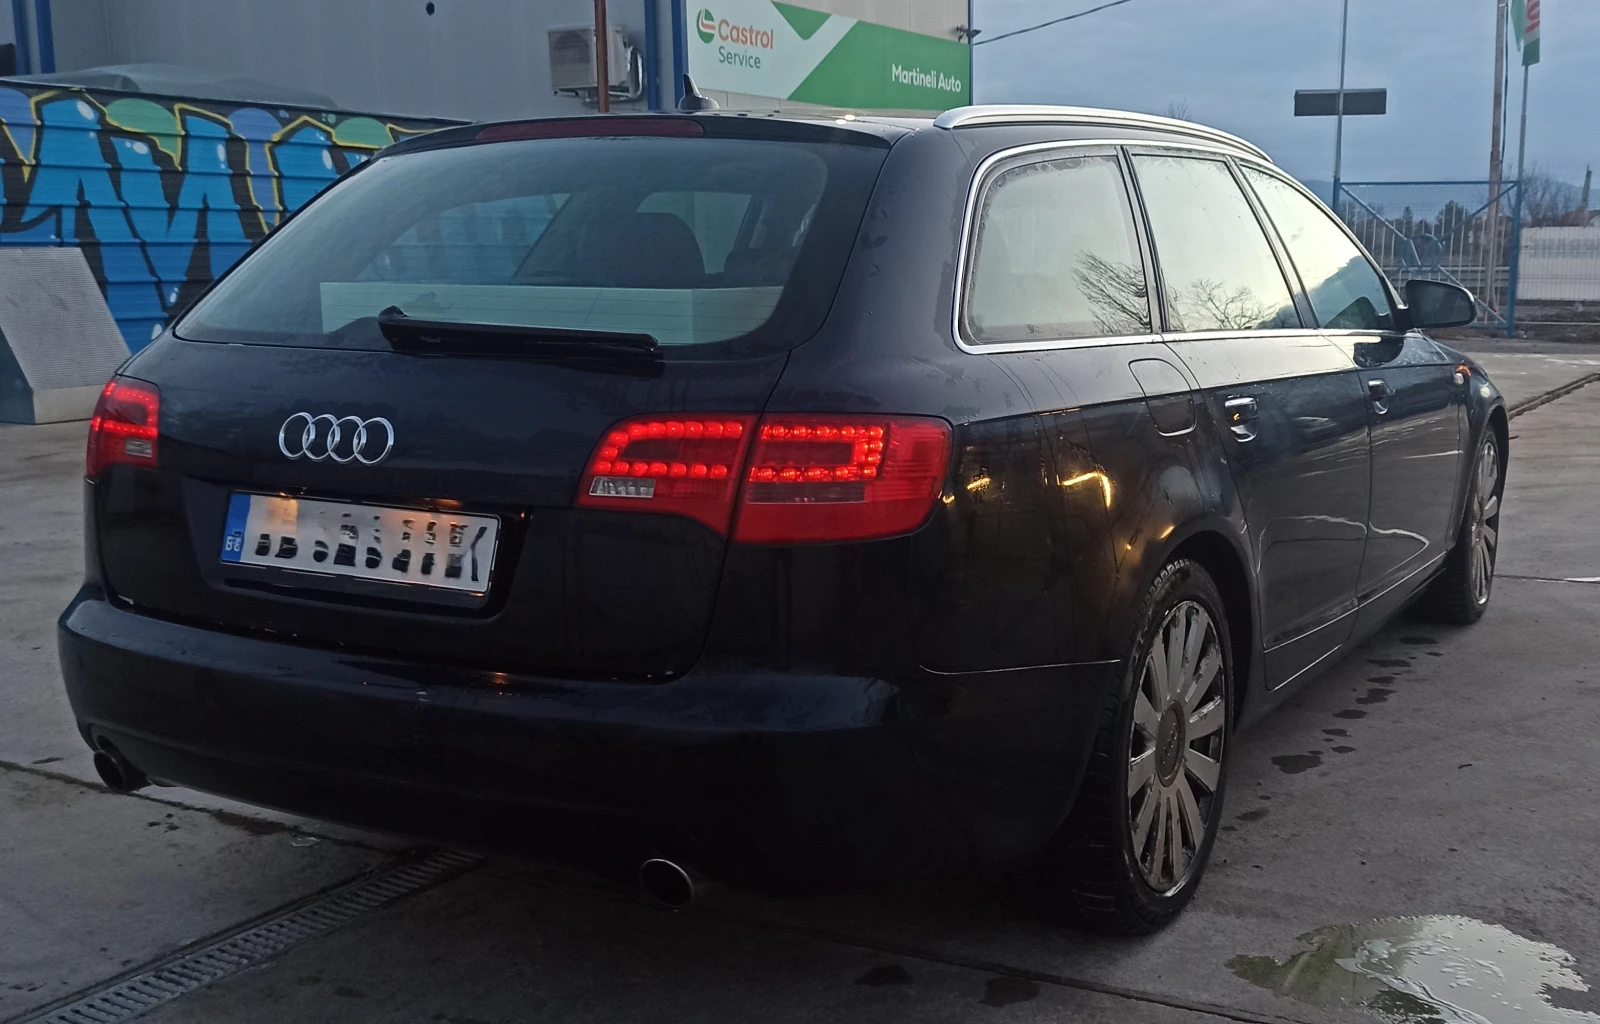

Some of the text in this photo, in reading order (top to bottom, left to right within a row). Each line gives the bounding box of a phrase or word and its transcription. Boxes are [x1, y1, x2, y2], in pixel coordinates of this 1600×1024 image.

[718, 18, 774, 50] Castrol
[718, 45, 761, 69] Service
[892, 63, 961, 93] Martineli Auto
